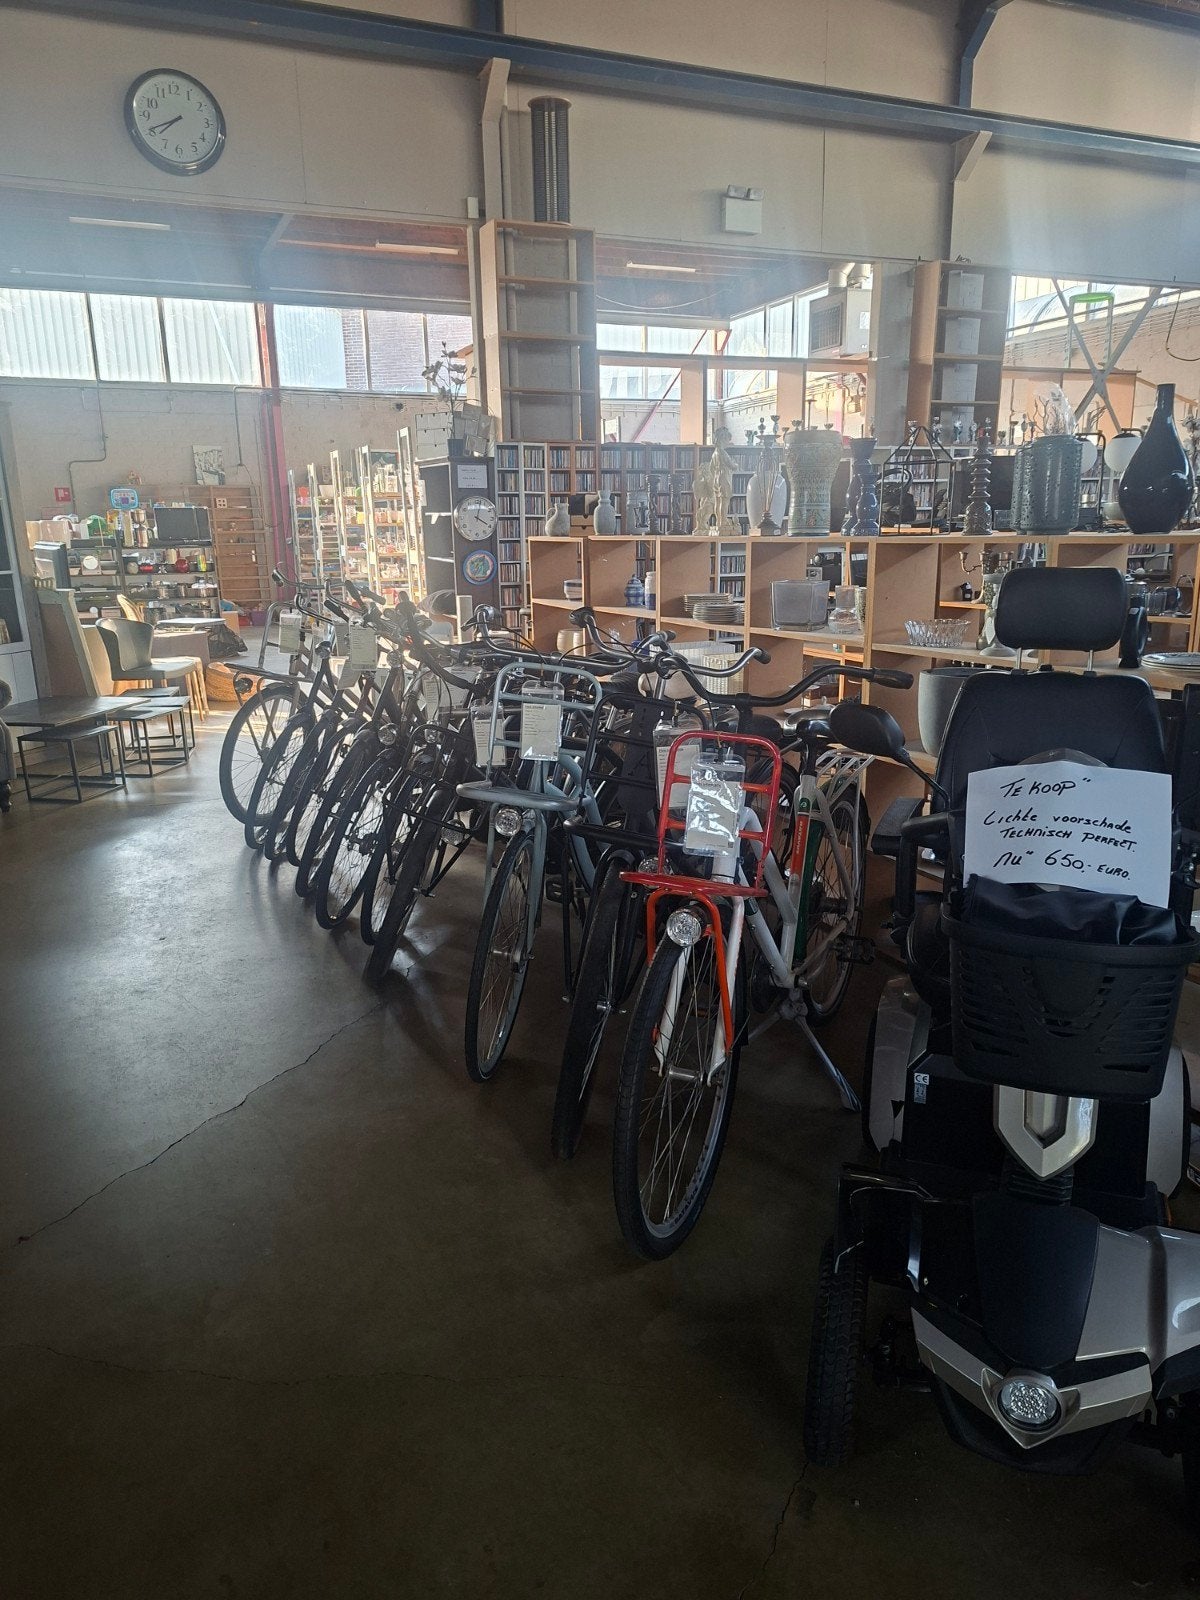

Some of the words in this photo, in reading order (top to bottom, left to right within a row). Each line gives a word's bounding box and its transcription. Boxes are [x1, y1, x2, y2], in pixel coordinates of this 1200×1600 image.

[155, 86, 165, 98] 11
[168, 84, 180, 95] 12
[147, 98, 158, 109] 10
[196, 102, 203, 112] 2
[143, 110, 151, 121] 9
[204, 117, 210, 128] 3
[199, 132, 206, 142] 4
[162, 138, 168, 150] 7
[175, 144, 183, 155] 6
[191, 142, 198, 153] 5
